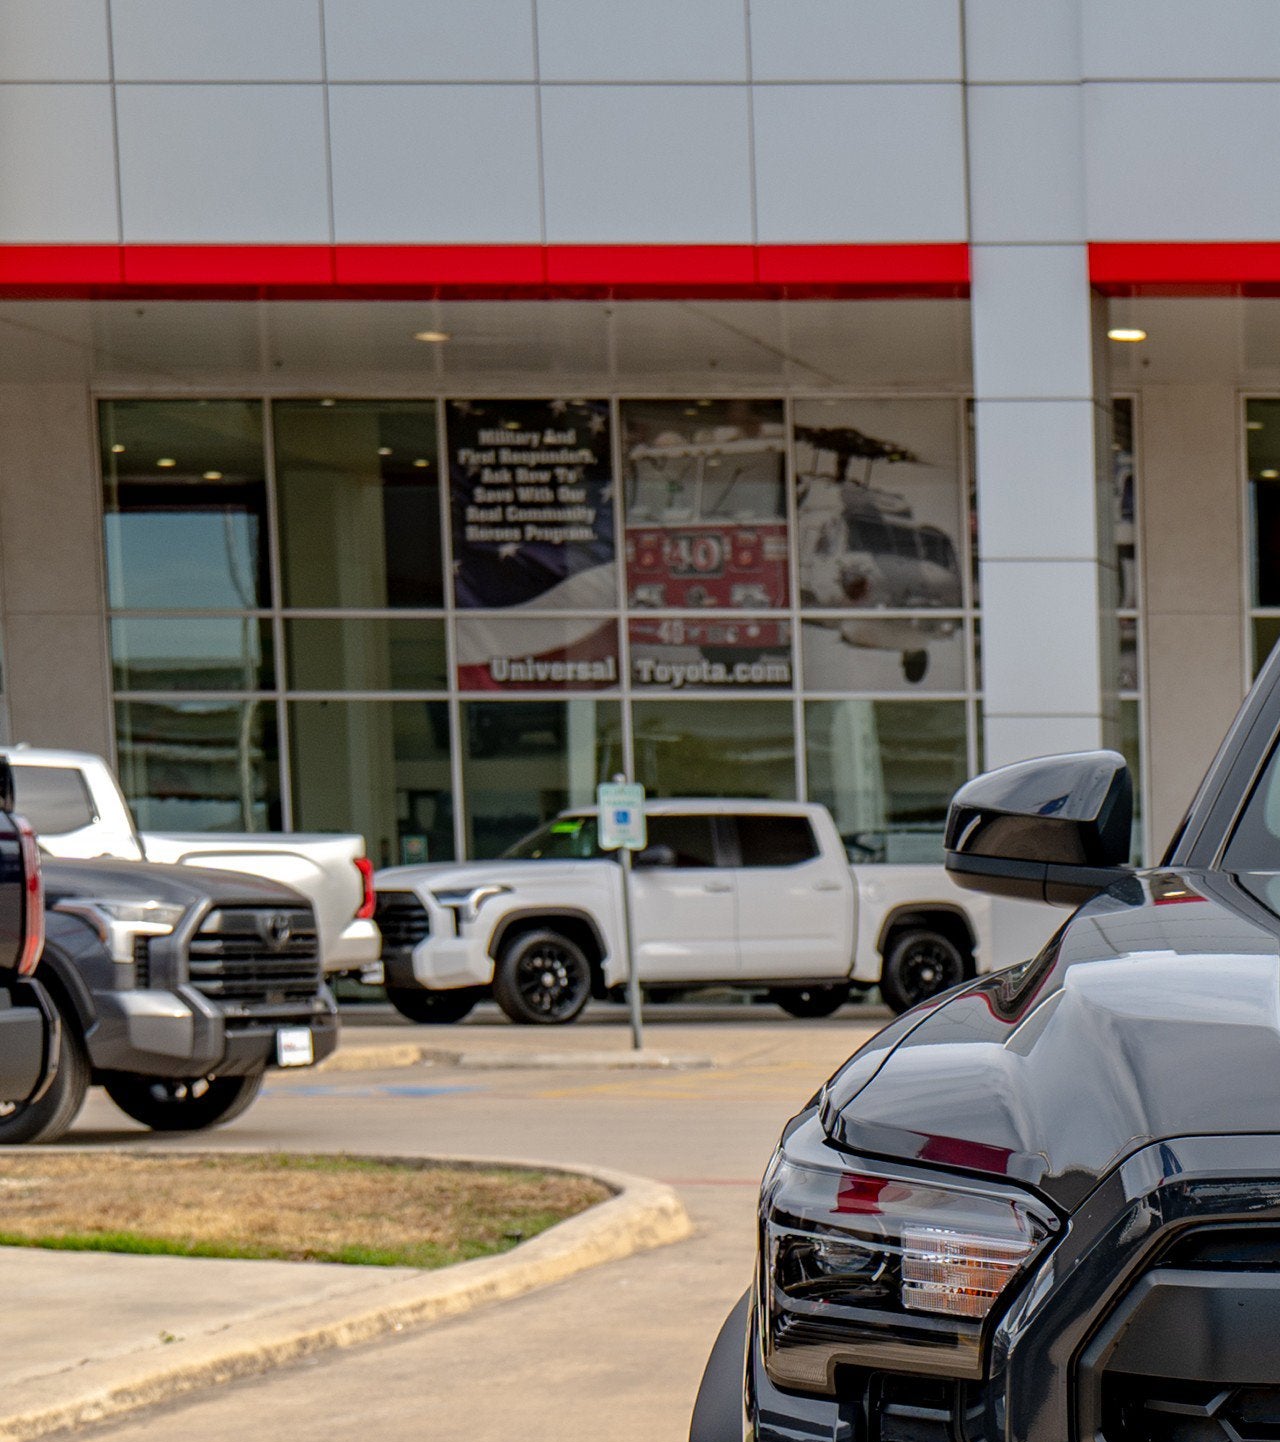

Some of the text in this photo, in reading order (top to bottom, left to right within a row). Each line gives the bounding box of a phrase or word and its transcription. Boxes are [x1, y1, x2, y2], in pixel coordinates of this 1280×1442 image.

[478, 428, 577, 447] Military And
[481, 467, 512, 484] Ask
[473, 486, 514, 503] Save
[516, 486, 555, 503] With
[490, 656, 791, 689] Universal Toyota.com
